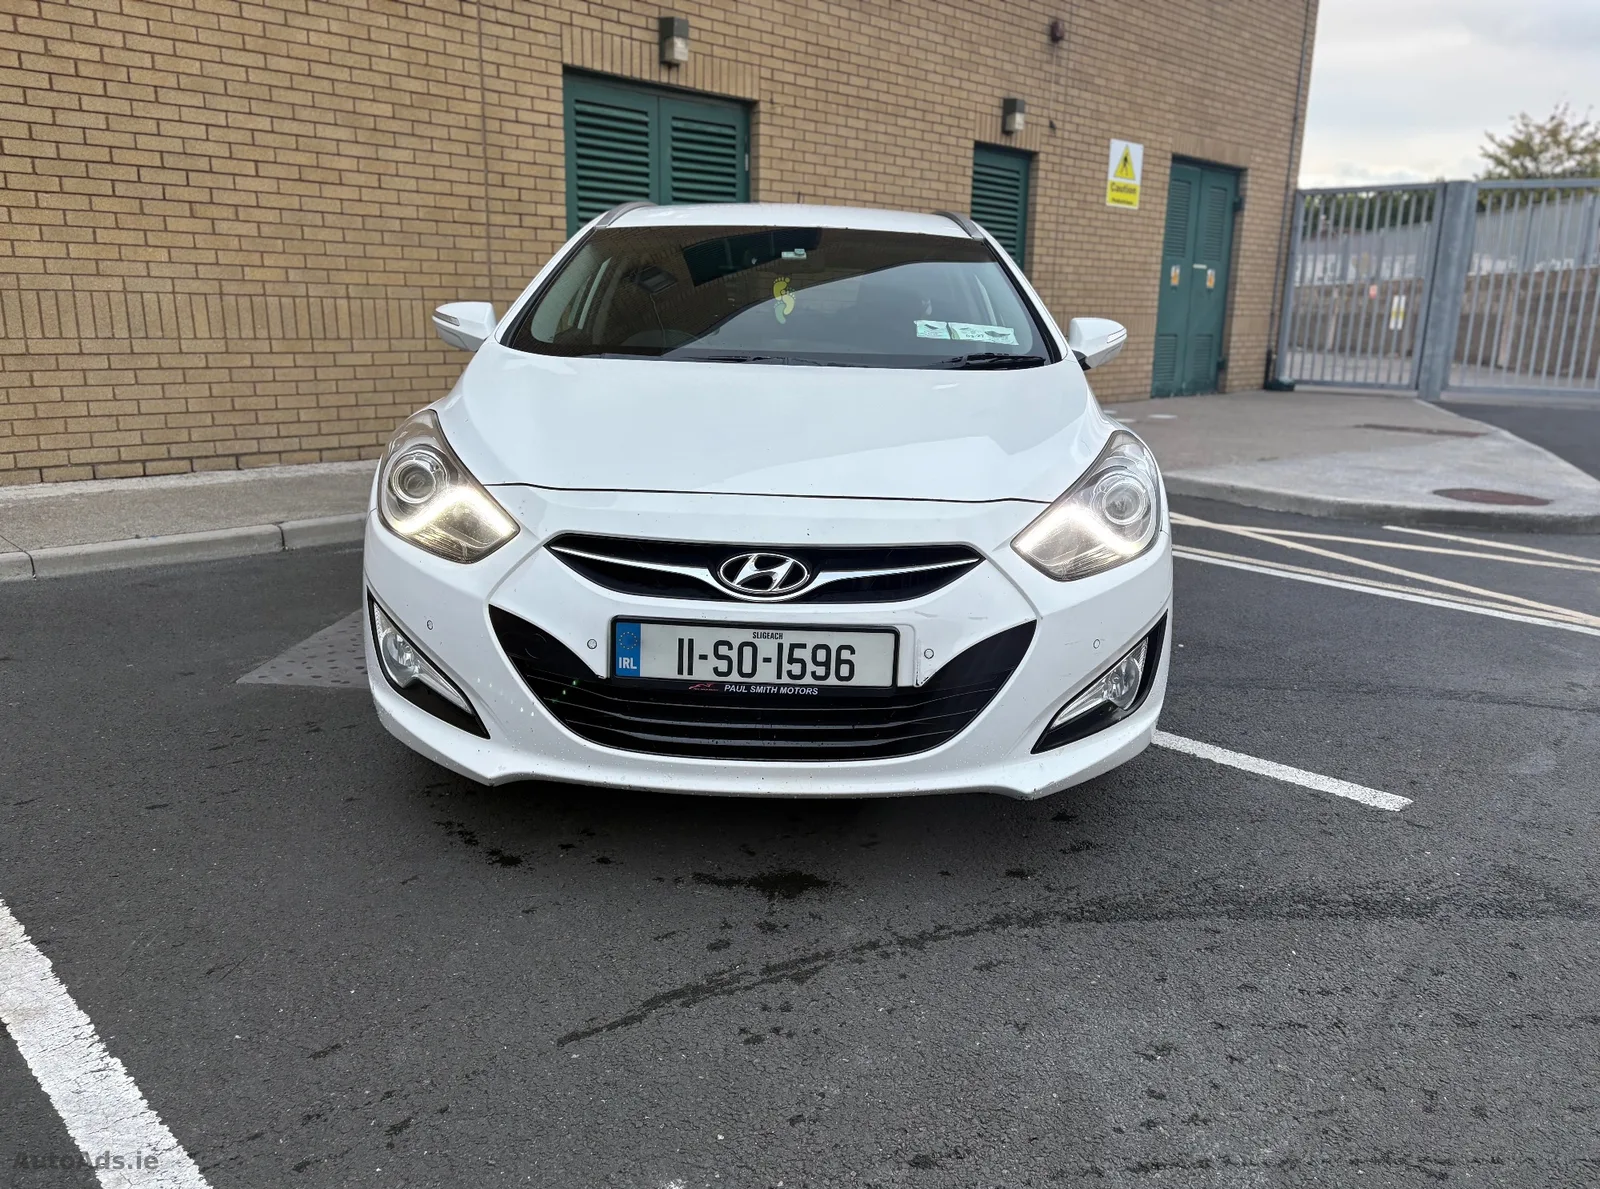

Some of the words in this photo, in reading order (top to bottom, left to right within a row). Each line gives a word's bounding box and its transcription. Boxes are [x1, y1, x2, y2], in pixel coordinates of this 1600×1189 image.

[1110, 182, 1137, 195] Caution
[752, 631, 784, 640] SLIGEACH
[618, 657, 638, 669] IRL
[677, 637, 856, 682] 11-SO-1596
[724, 684, 748, 693] PAUL
[750, 685, 778, 694] SMITH
[780, 686, 819, 695] MOTORS
